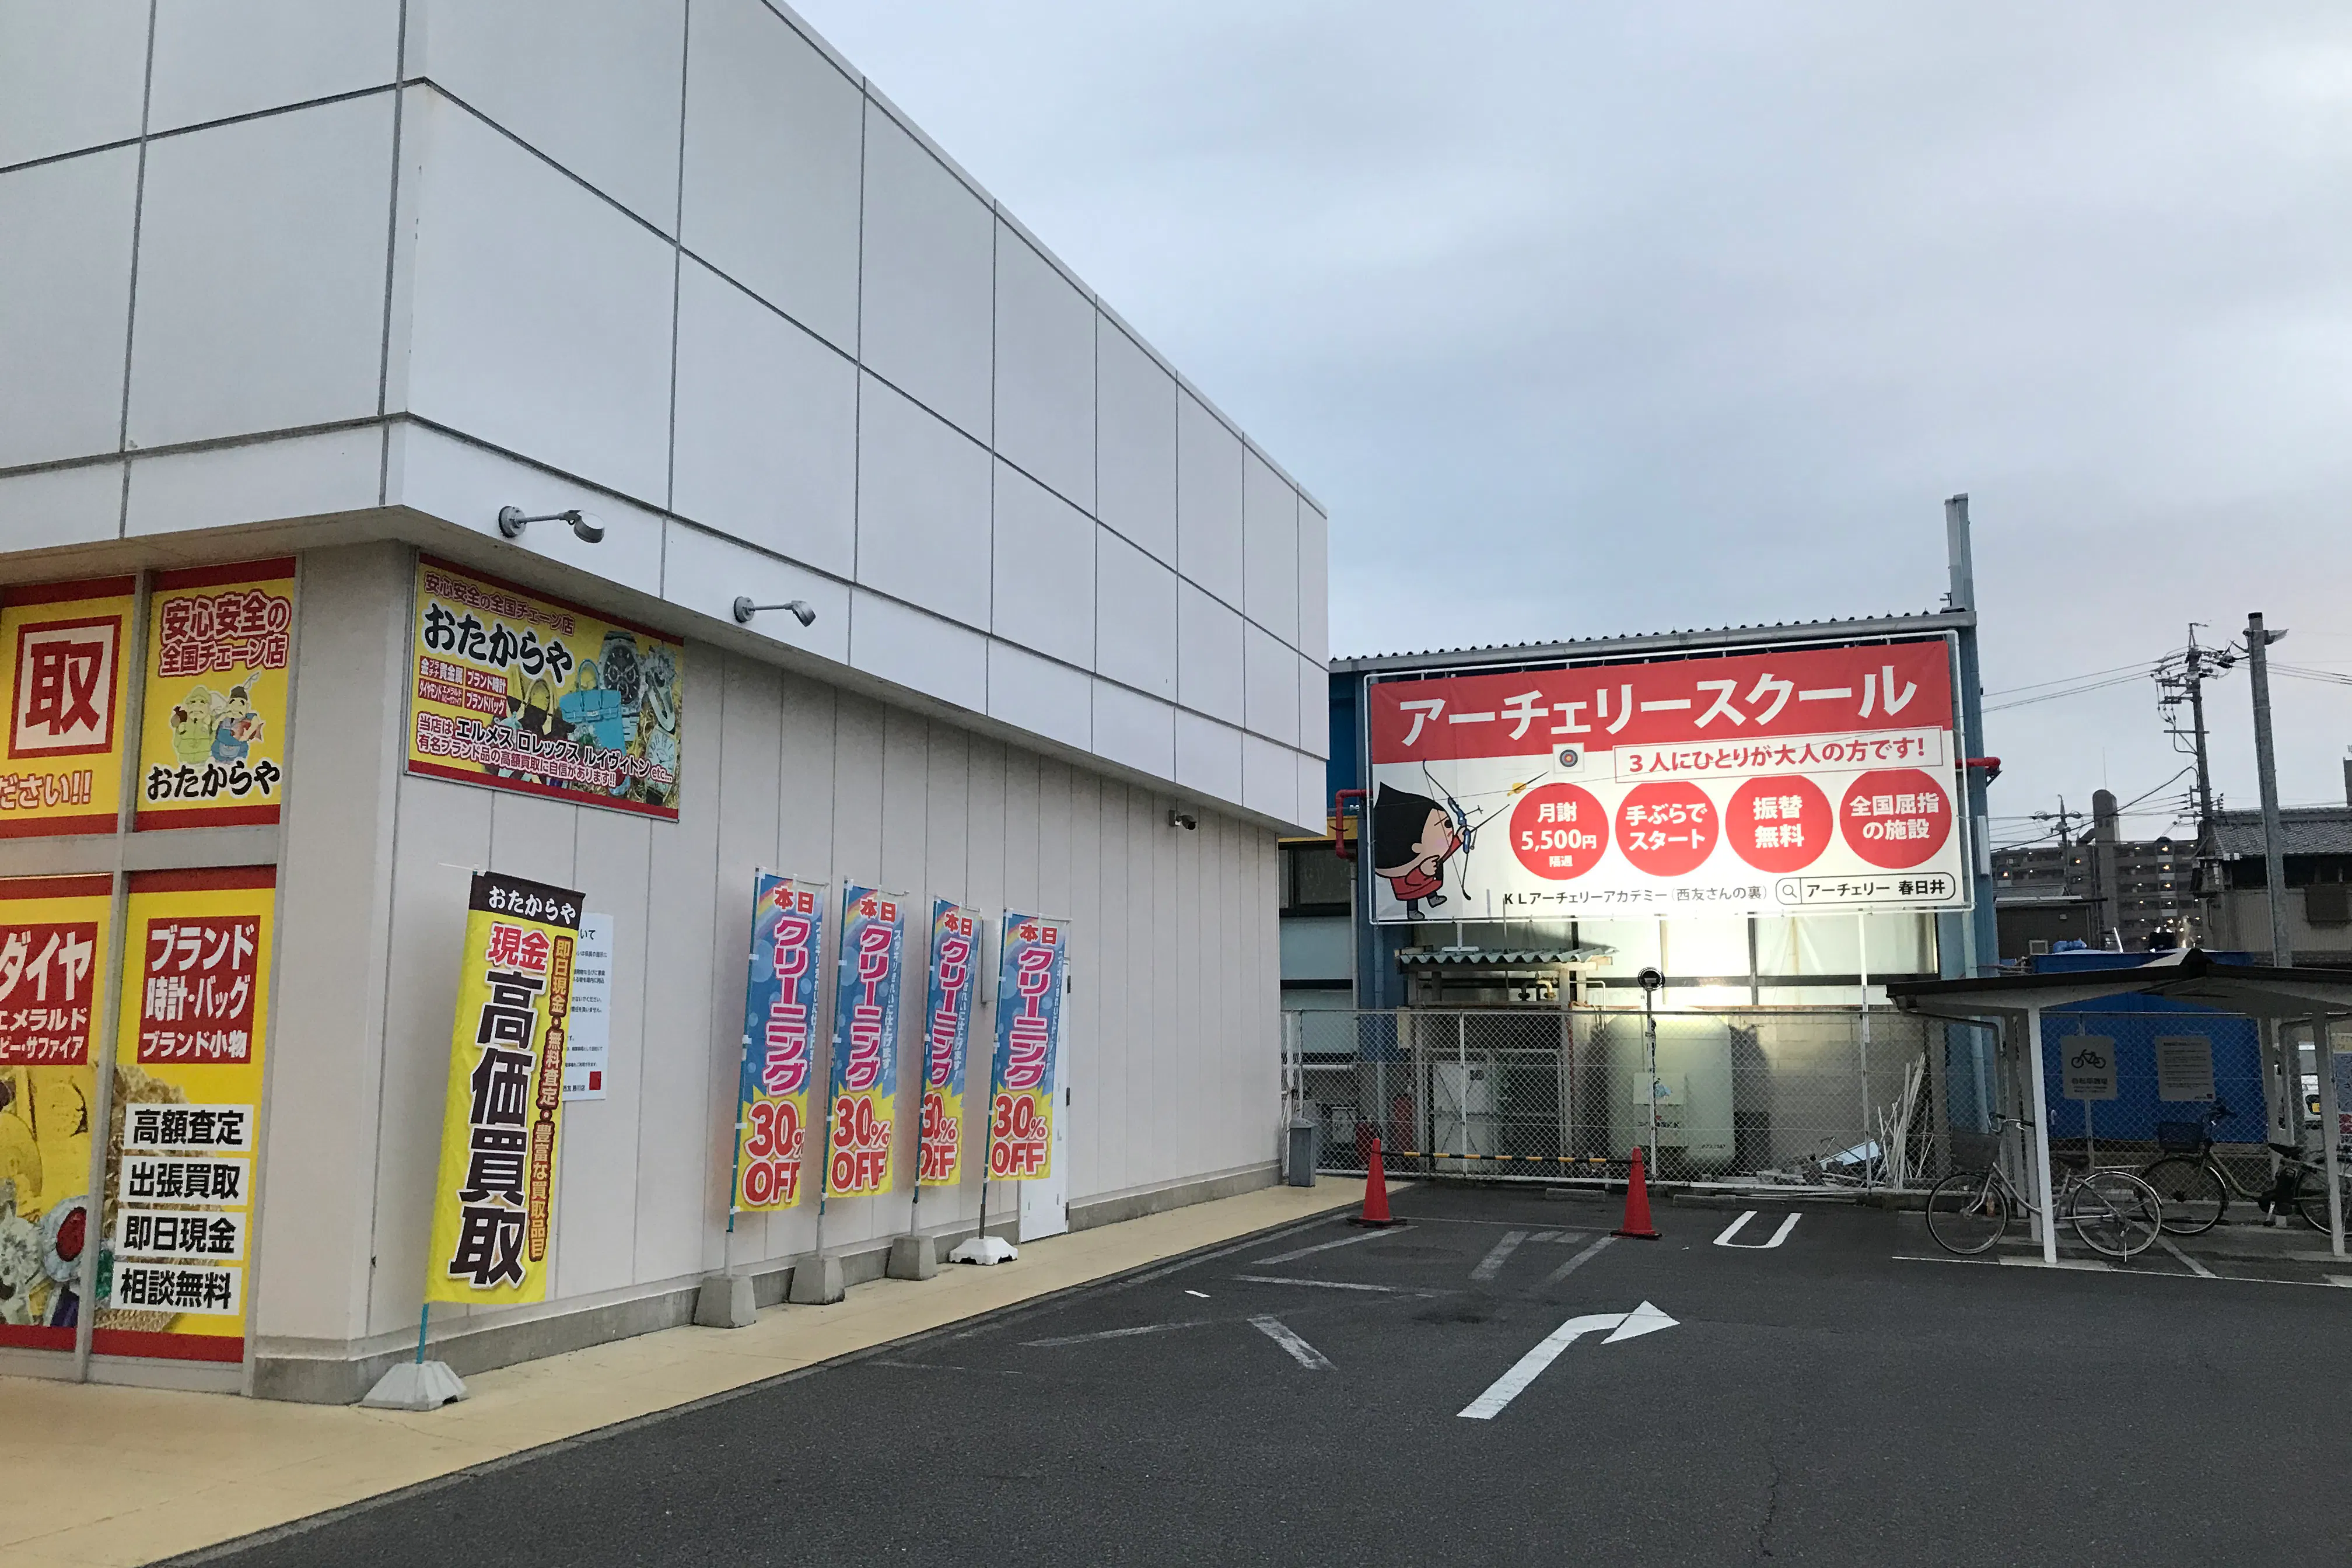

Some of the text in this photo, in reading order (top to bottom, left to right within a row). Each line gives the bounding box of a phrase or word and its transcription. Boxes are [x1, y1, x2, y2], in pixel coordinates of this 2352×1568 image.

[163, 590, 290, 642] 安心安全の
[424, 572, 575, 635] 安心安全の全国チェーン店
[159, 634, 288, 676] 全国チェーン店
[424, 603, 573, 684] おたからや
[25, 640, 104, 736] 取
[467, 671, 506, 694] ブランド時計
[467, 692, 505, 715] ブランドバッグ
[1400, 666, 1917, 746] アーチェリースクール
[418, 712, 453, 736] 当店は
[456, 718, 514, 749] エルメス
[517, 731, 579, 764] ロレックス
[583, 746, 651, 778] ルイヴィトン
[1629, 737, 1925, 773] 3人にひとりが大人の方です!
[148, 760, 281, 799] おたからや
[1537, 802, 1577, 822] 月謝
[1625, 802, 1707, 825] 手ぶらで
[1753, 796, 1803, 820] 振替
[1849, 792, 1940, 817] 全国屈指
[1521, 830, 1597, 852] 5,500円
[1629, 829, 1705, 850] スタート
[1755, 824, 1804, 849] 無料
[1862, 818, 1930, 841] の施設
[488, 886, 576, 924] おたからや
[774, 887, 814, 915] 本日
[1807, 879, 1945, 897] アーチェリー 春日井
[860, 898, 897, 923] 本日
[944, 912, 973, 937] 本日
[151, 924, 254, 972] ブランド
[487, 921, 551, 973] 現金
[1020, 922, 1058, 945] 本日
[0, 931, 93, 1002] ダイヤ
[145, 974, 250, 1021] 時計・バッグ
[762, 916, 810, 1096] クリーニング
[846, 925, 892, 1091] クリーニング
[932, 937, 970, 1088] クリーニング
[1005, 947, 1054, 1090] クリーニング
[142, 1030, 247, 1058] ブランド小物
[133, 1110, 244, 1145] 高額査定
[448, 969, 545, 1287] 高価買取
[834, 1096, 891, 1149] 30%
[922, 1092, 958, 1143] 30%
[993, 1094, 1048, 1140] 30%
[832, 1150, 887, 1191] OFF
[992, 1140, 1046, 1175] OFF
[129, 1161, 240, 1199] 出張買取
[124, 1216, 236, 1254] 即日現金
[120, 1268, 232, 1309] 相談無料
